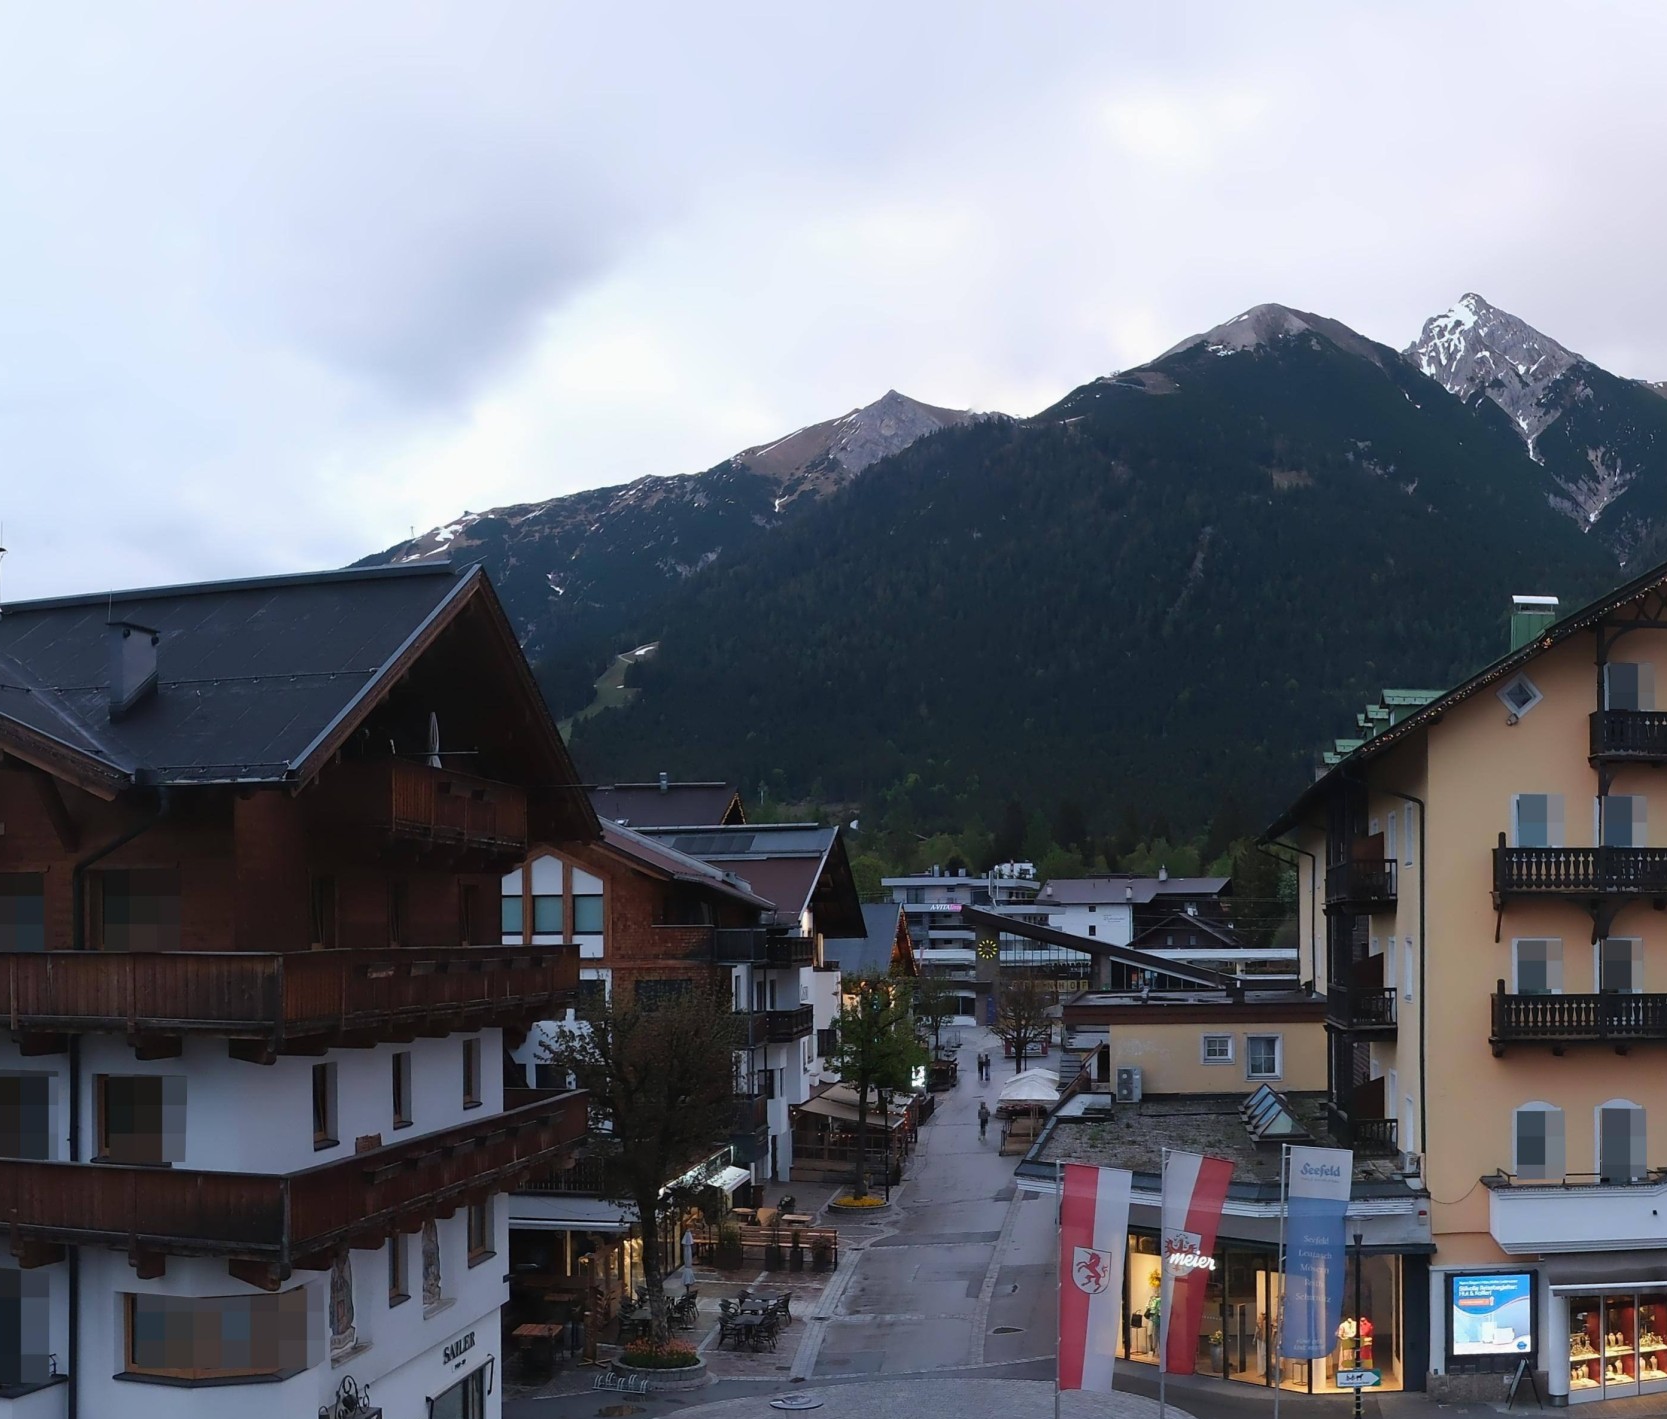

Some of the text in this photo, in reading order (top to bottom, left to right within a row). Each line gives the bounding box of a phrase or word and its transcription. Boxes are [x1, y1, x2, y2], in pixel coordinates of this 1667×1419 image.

[1300, 1162, 1341, 1177] Seefeld
[1169, 1250, 1217, 1271] meier
[443, 1331, 475, 1365] SAILER
